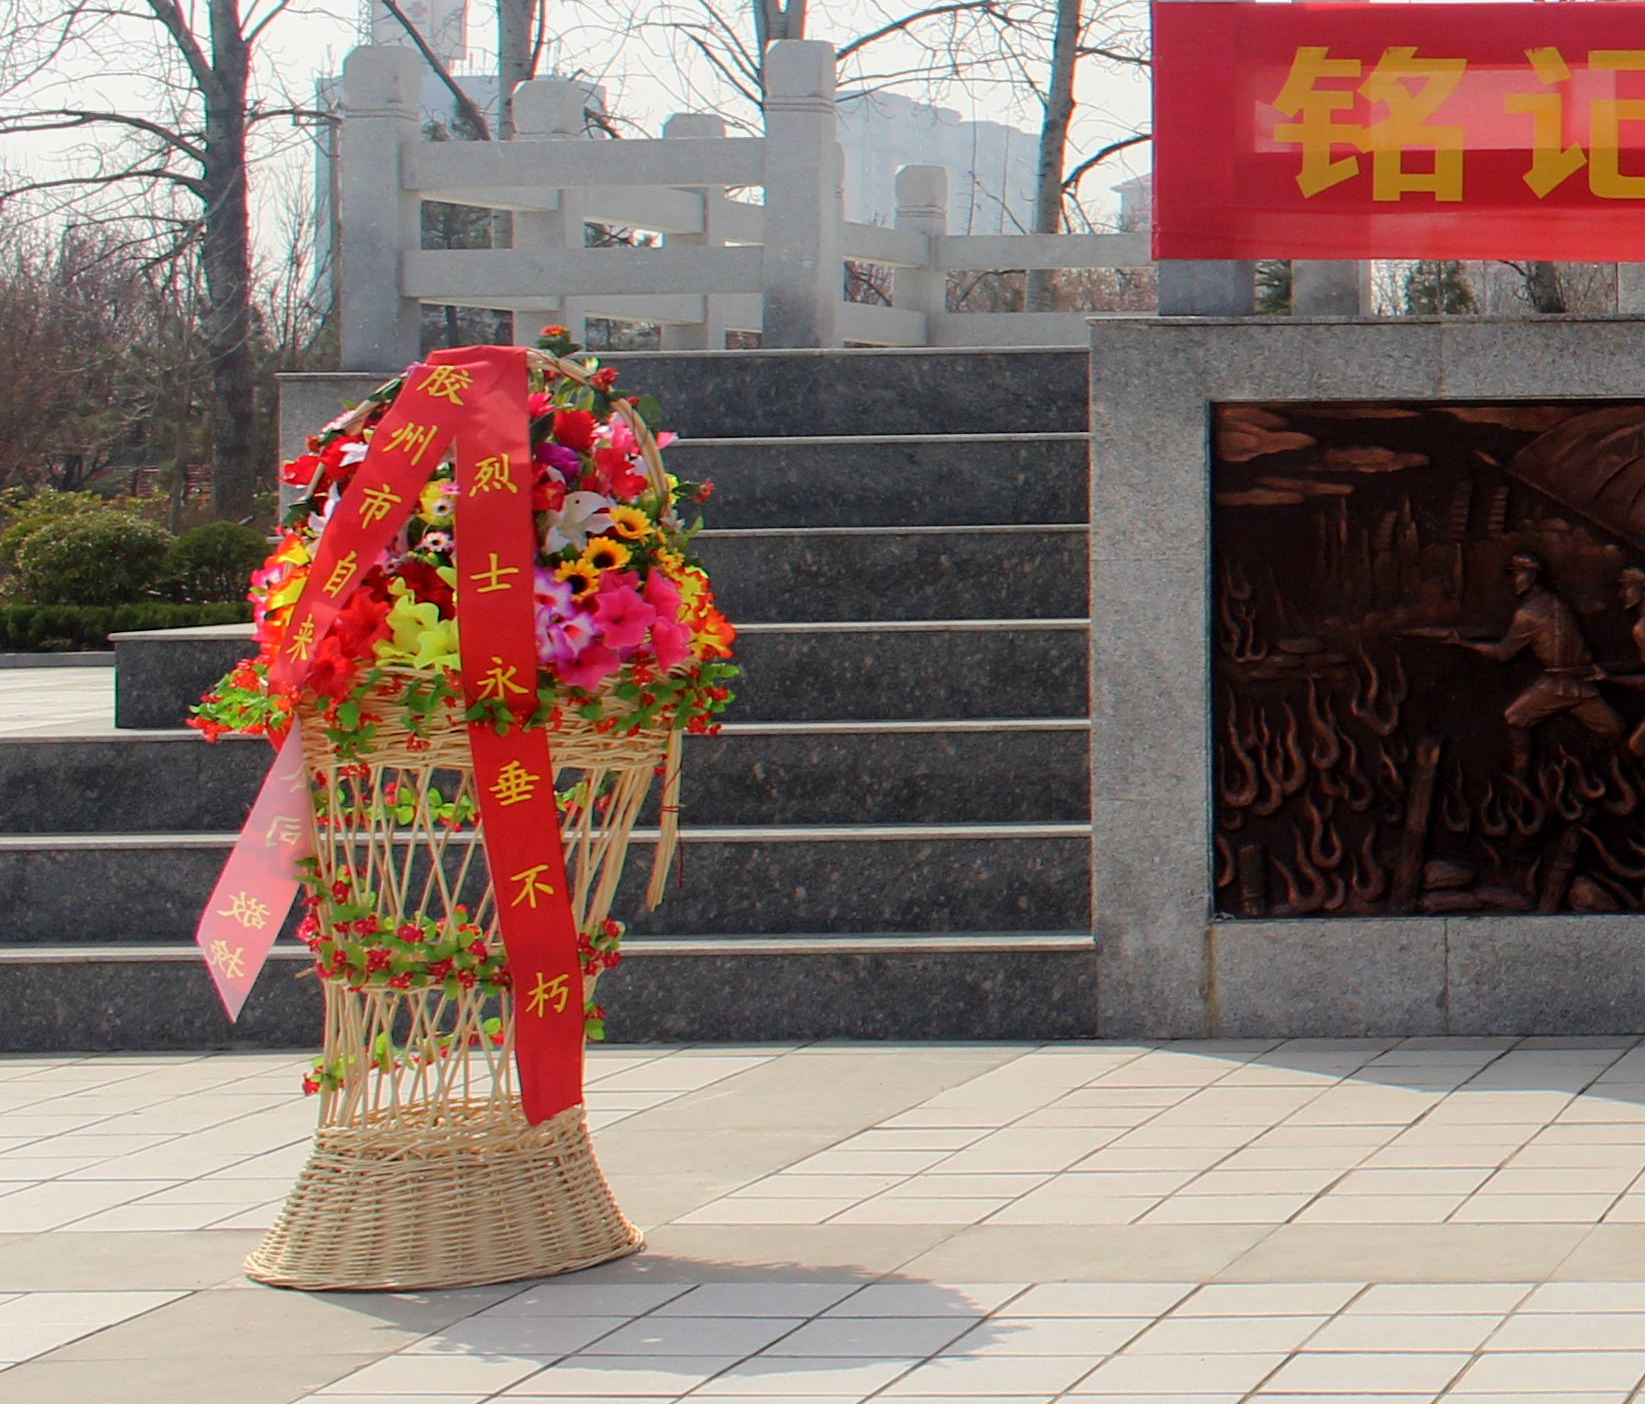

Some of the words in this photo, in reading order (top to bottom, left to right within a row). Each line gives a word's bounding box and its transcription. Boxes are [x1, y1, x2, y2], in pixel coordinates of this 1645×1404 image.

[469, 453, 570, 1017] 烈士永垂不朽
